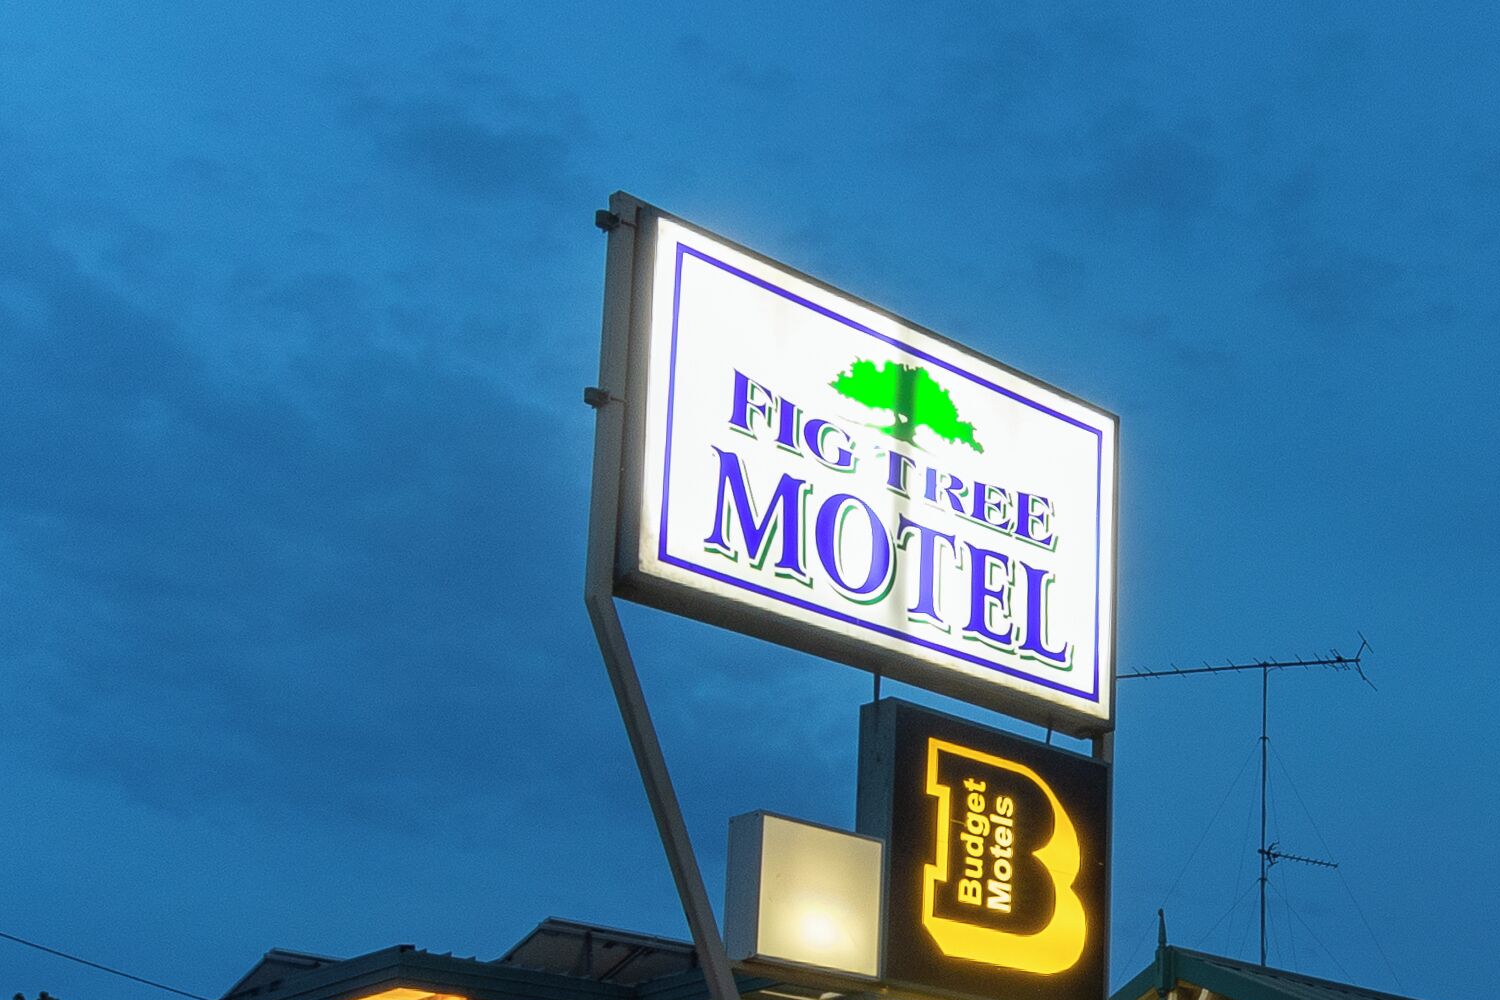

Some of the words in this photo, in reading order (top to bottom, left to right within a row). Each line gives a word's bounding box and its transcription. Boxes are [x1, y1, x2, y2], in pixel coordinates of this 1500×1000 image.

[728, 367, 858, 474] FIG
[875, 444, 1056, 552] TREE
[703, 445, 1074, 672] MOTEL
[921, 736, 1087, 976] B
[957, 777, 990, 906] Budget
[986, 794, 1014, 914] Motels
